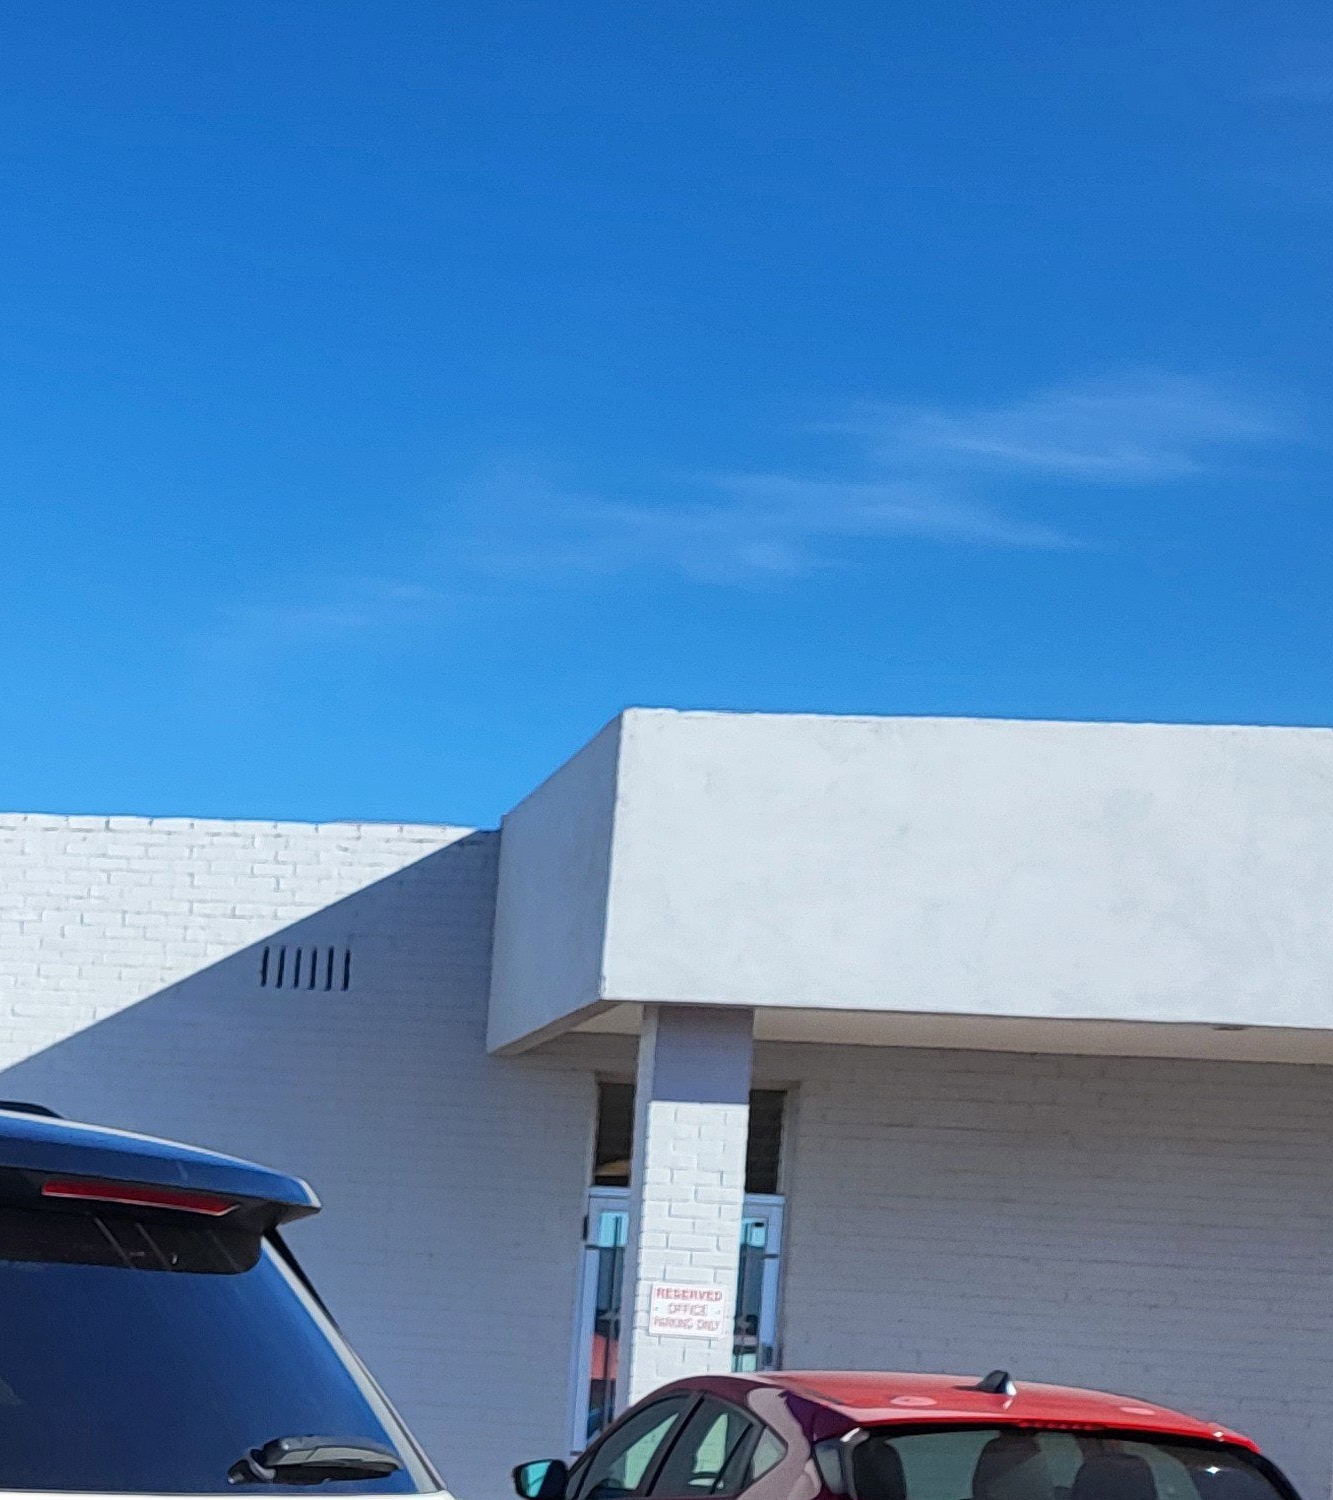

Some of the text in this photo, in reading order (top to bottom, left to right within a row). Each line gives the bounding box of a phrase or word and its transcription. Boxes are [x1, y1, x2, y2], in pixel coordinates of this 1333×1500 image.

[656, 1287, 723, 1302] RESERVED
[668, 1302, 708, 1317] OFFICE
[654, 1316, 693, 1330] PARKING
